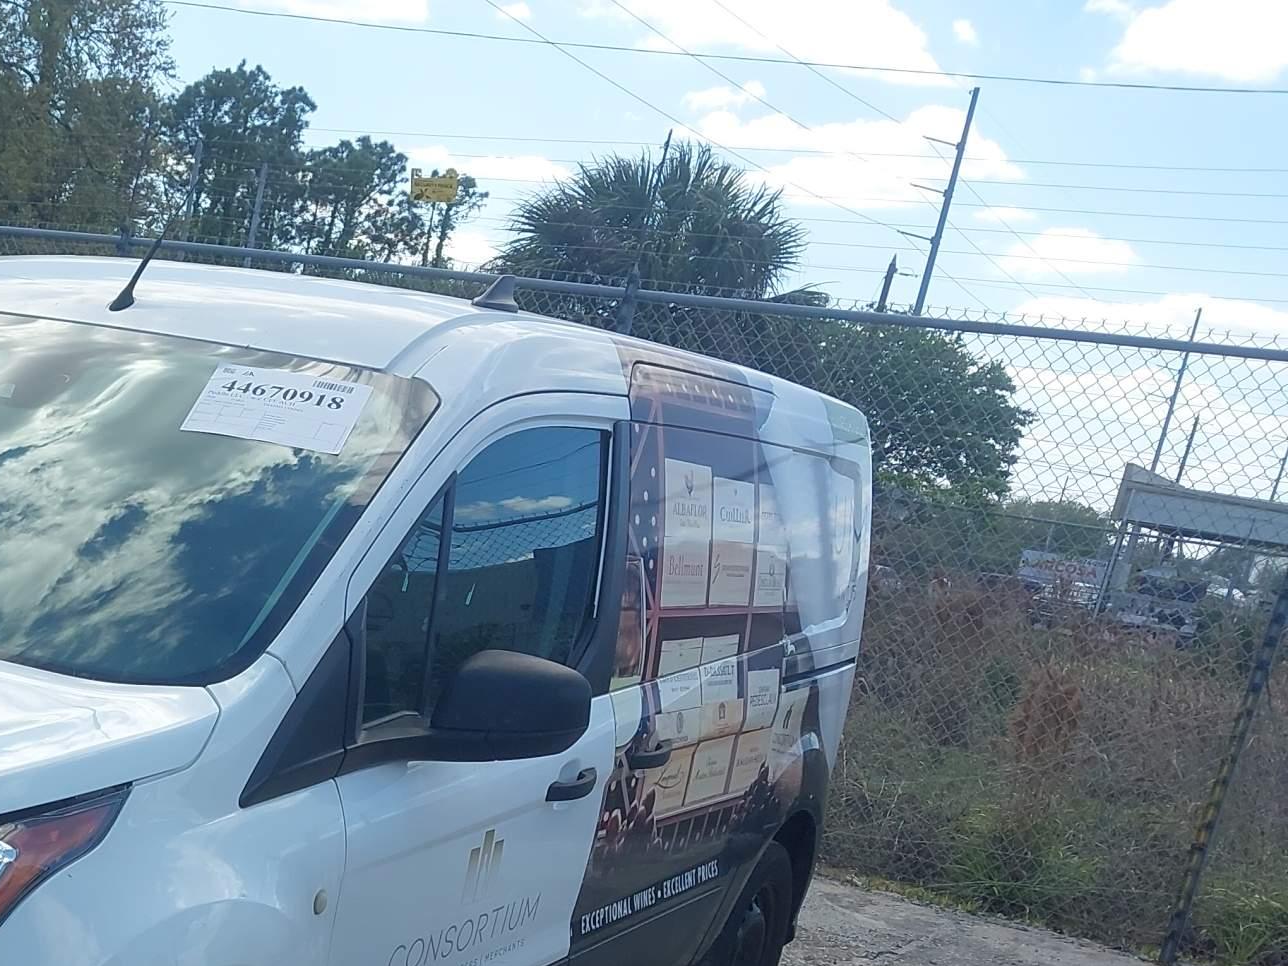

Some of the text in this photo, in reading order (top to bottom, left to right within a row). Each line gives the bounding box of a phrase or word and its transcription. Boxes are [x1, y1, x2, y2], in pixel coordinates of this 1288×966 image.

[221, 380, 345, 410] 44670918
[581, 897, 632, 935] EXCEPTIONAL
[633, 886, 656, 911] WINES
[663, 869, 696, 898] EXCELLENT
[697, 860, 719, 883] PRICES
[485, 938, 526, 963] MERCHANTS
